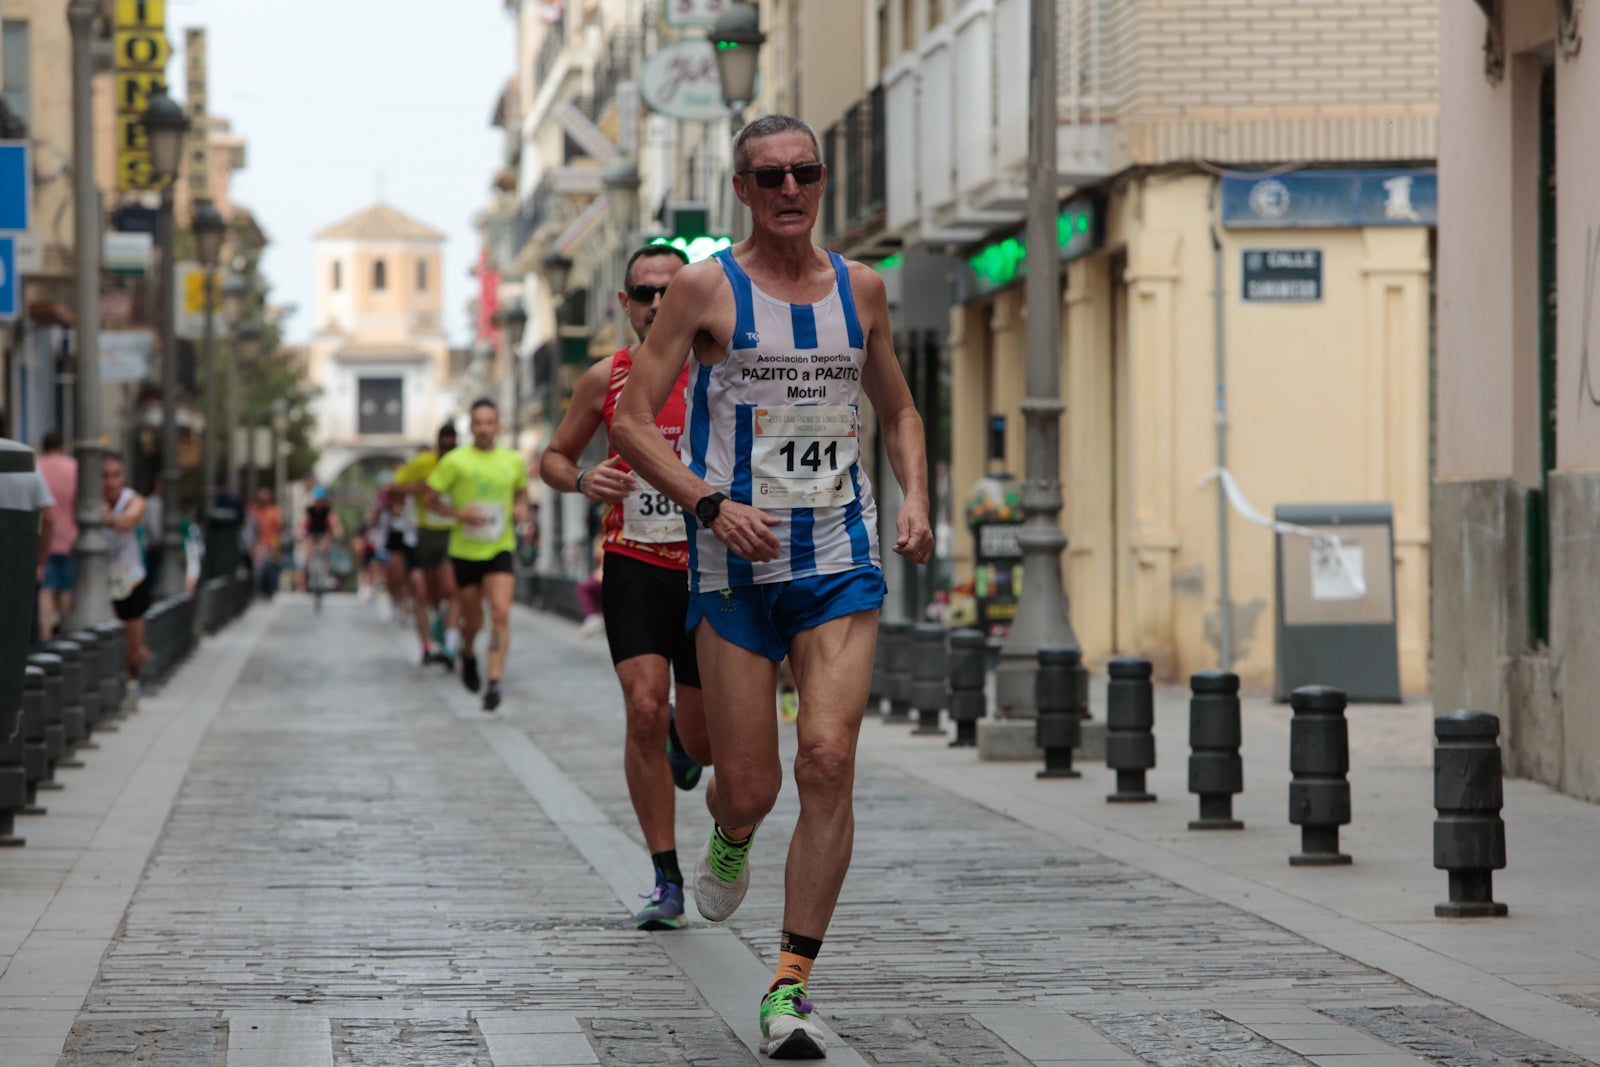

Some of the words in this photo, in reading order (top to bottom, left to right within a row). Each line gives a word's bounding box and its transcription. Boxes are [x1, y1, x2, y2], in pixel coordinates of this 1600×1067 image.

[757, 354, 809, 364] Asociación
[811, 353, 852, 364] Deportiva
[742, 367, 799, 381] PAZITO
[802, 371, 810, 381] a
[815, 367, 859, 381] PAZITO
[787, 385, 826, 398] Motril
[779, 441, 838, 472] 141
